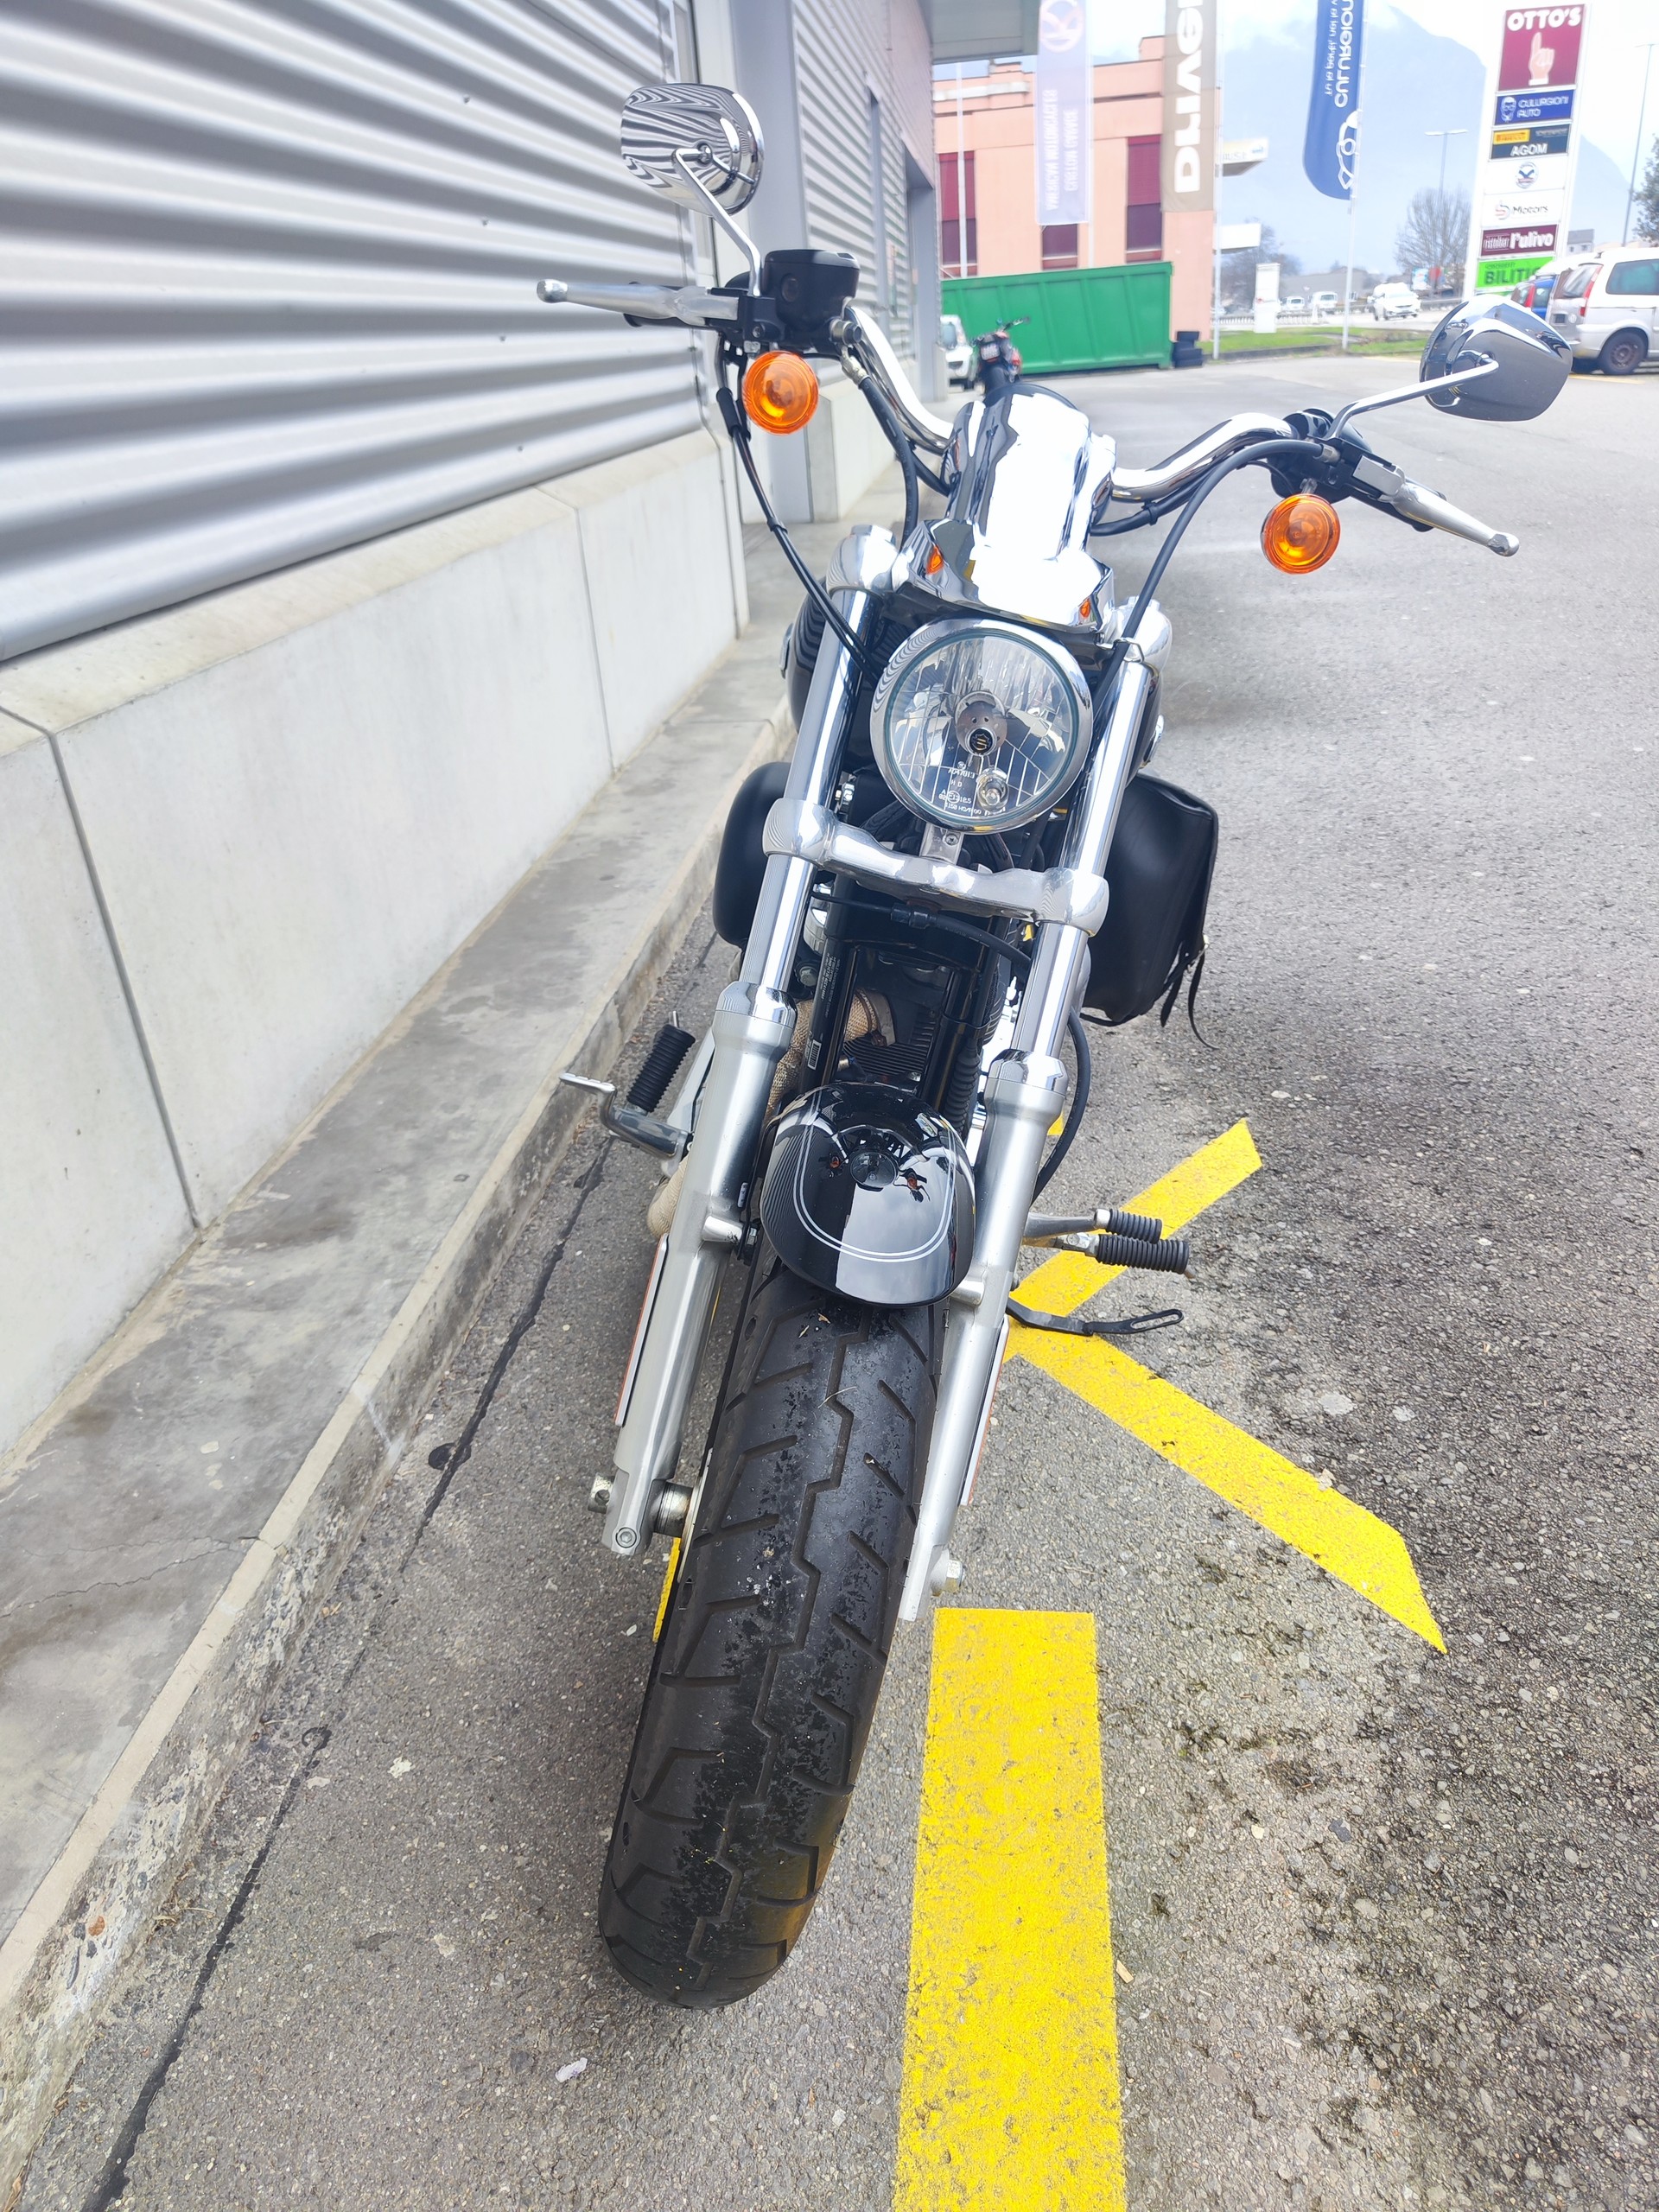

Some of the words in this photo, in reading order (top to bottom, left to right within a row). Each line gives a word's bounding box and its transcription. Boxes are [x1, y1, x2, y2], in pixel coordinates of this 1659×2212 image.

[1507, 7, 1581, 31] OTTO'S
[1516, 108, 1541, 118] AUTO
[1510, 143, 1548, 156] AGOM
